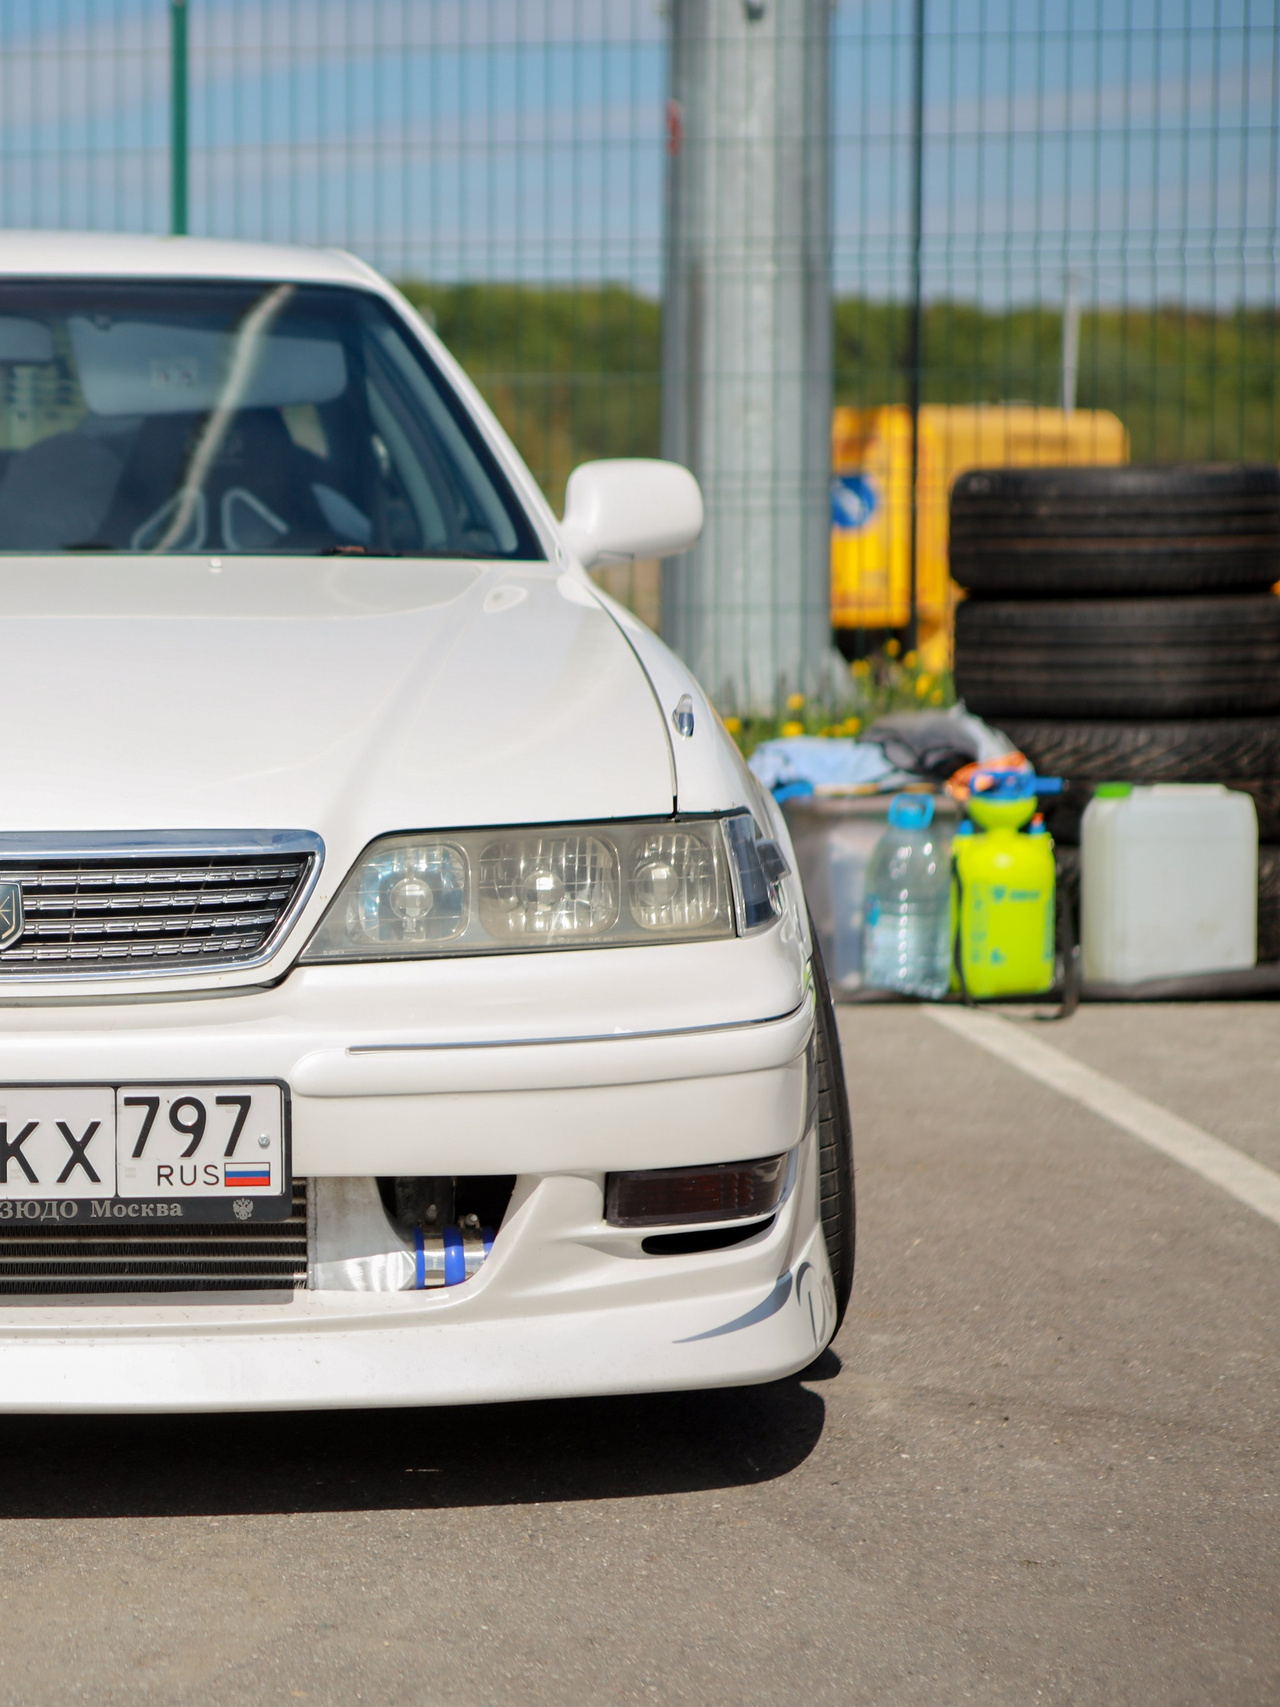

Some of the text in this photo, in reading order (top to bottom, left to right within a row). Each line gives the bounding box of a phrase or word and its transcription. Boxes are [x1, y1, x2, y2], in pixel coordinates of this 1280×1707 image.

[123, 1095, 252, 1159] 797
[157, 1164, 220, 1187] RUS
[90, 1200, 183, 1218] Москва
